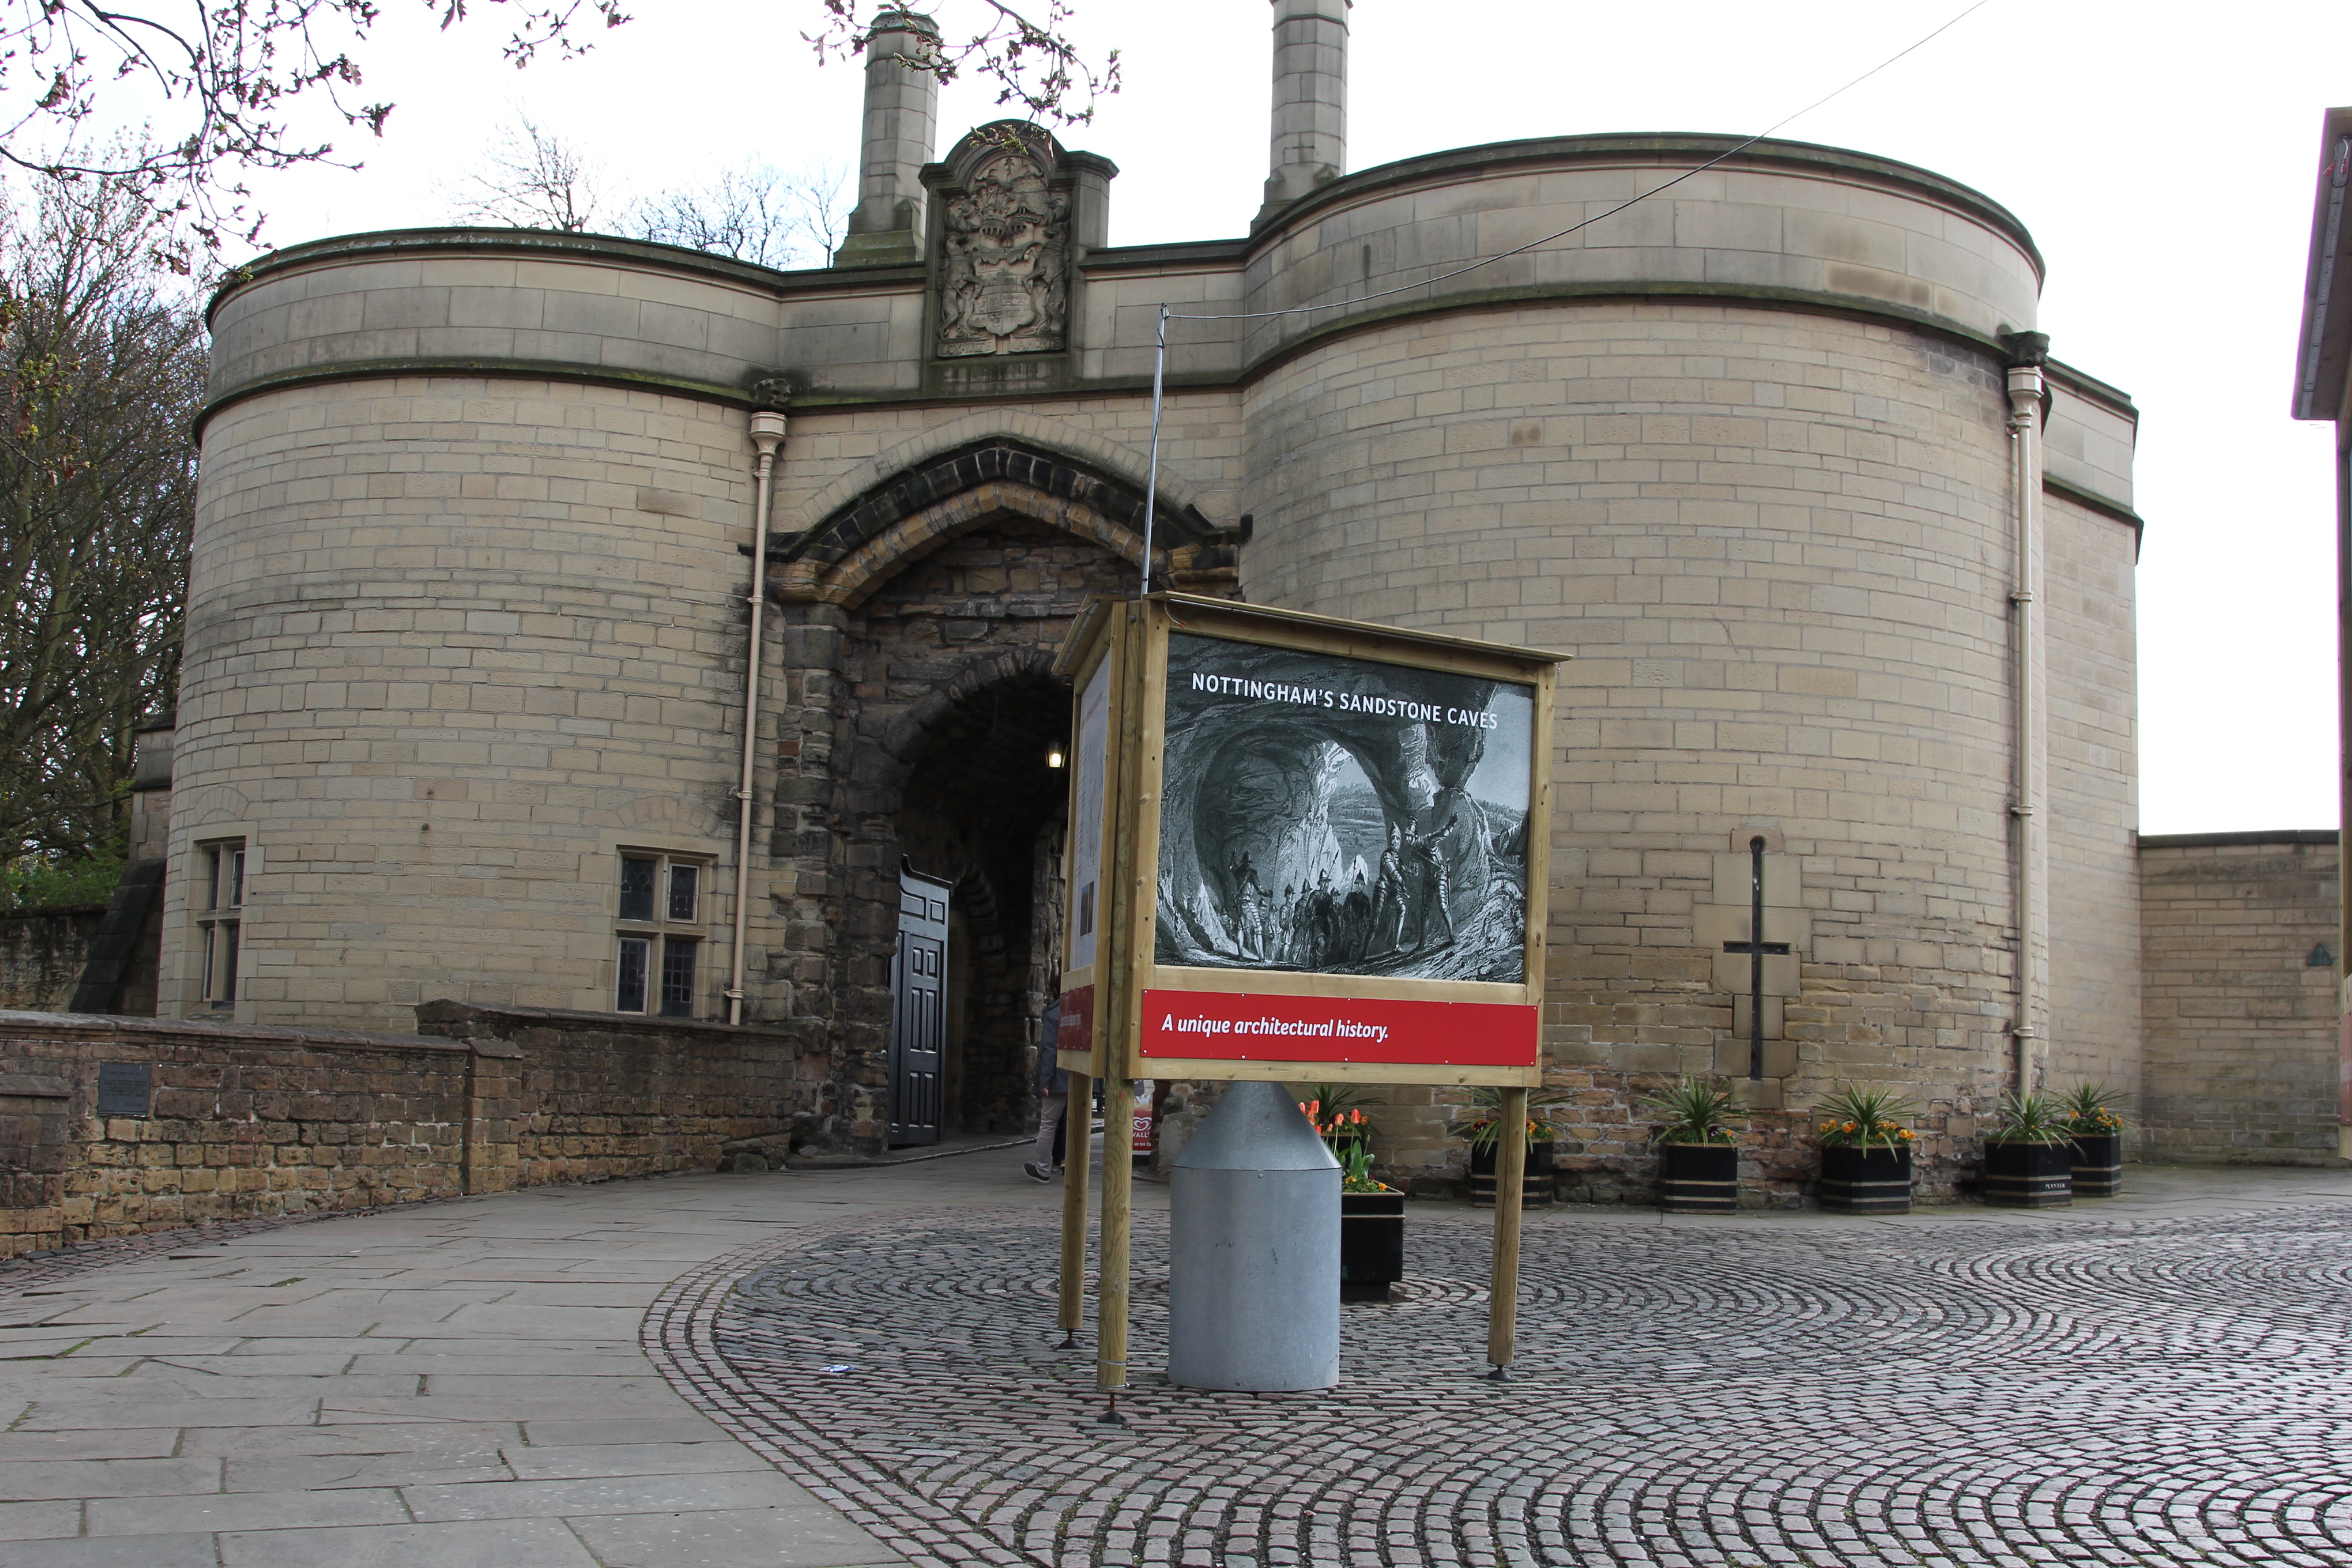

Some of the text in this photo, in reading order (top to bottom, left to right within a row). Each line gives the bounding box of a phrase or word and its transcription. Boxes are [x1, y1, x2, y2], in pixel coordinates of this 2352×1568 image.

[1192, 672, 1498, 730] NOTTINGHAM'S SANDSTONE CAVES
[1161, 1013, 1388, 1043] A unique architectural history.
